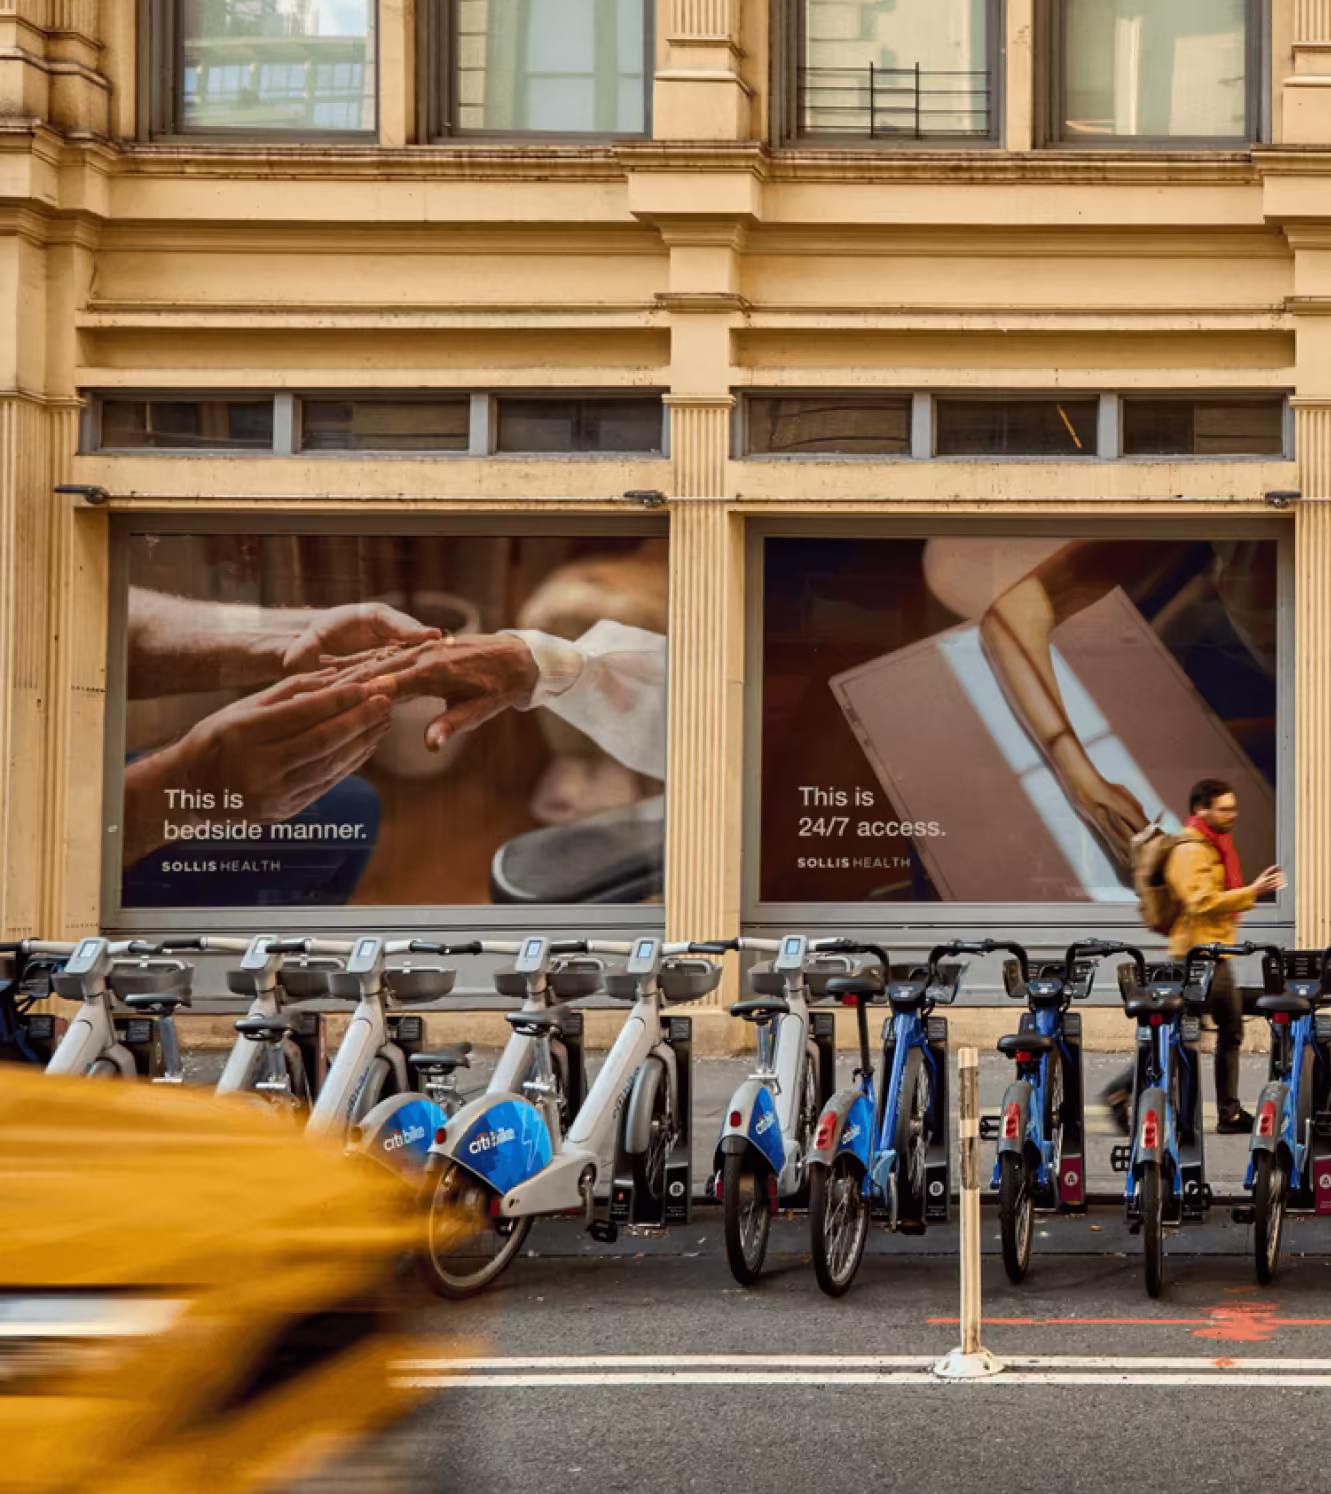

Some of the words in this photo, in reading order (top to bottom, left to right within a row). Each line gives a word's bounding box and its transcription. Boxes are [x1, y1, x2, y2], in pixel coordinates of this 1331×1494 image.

[163, 789, 215, 810] This
[223, 789, 244, 810] is
[798, 786, 848, 807] This
[854, 786, 875, 807] is
[163, 820, 263, 840] bedside
[270, 823, 367, 840] manner.
[798, 817, 850, 838] 24/7
[856, 820, 947, 837] access.
[162, 860, 217, 872] SOLLIS
[220, 860, 281, 872] HEALTH
[797, 857, 850, 868] SOLLIS
[853, 857, 911, 868] HEALTH
